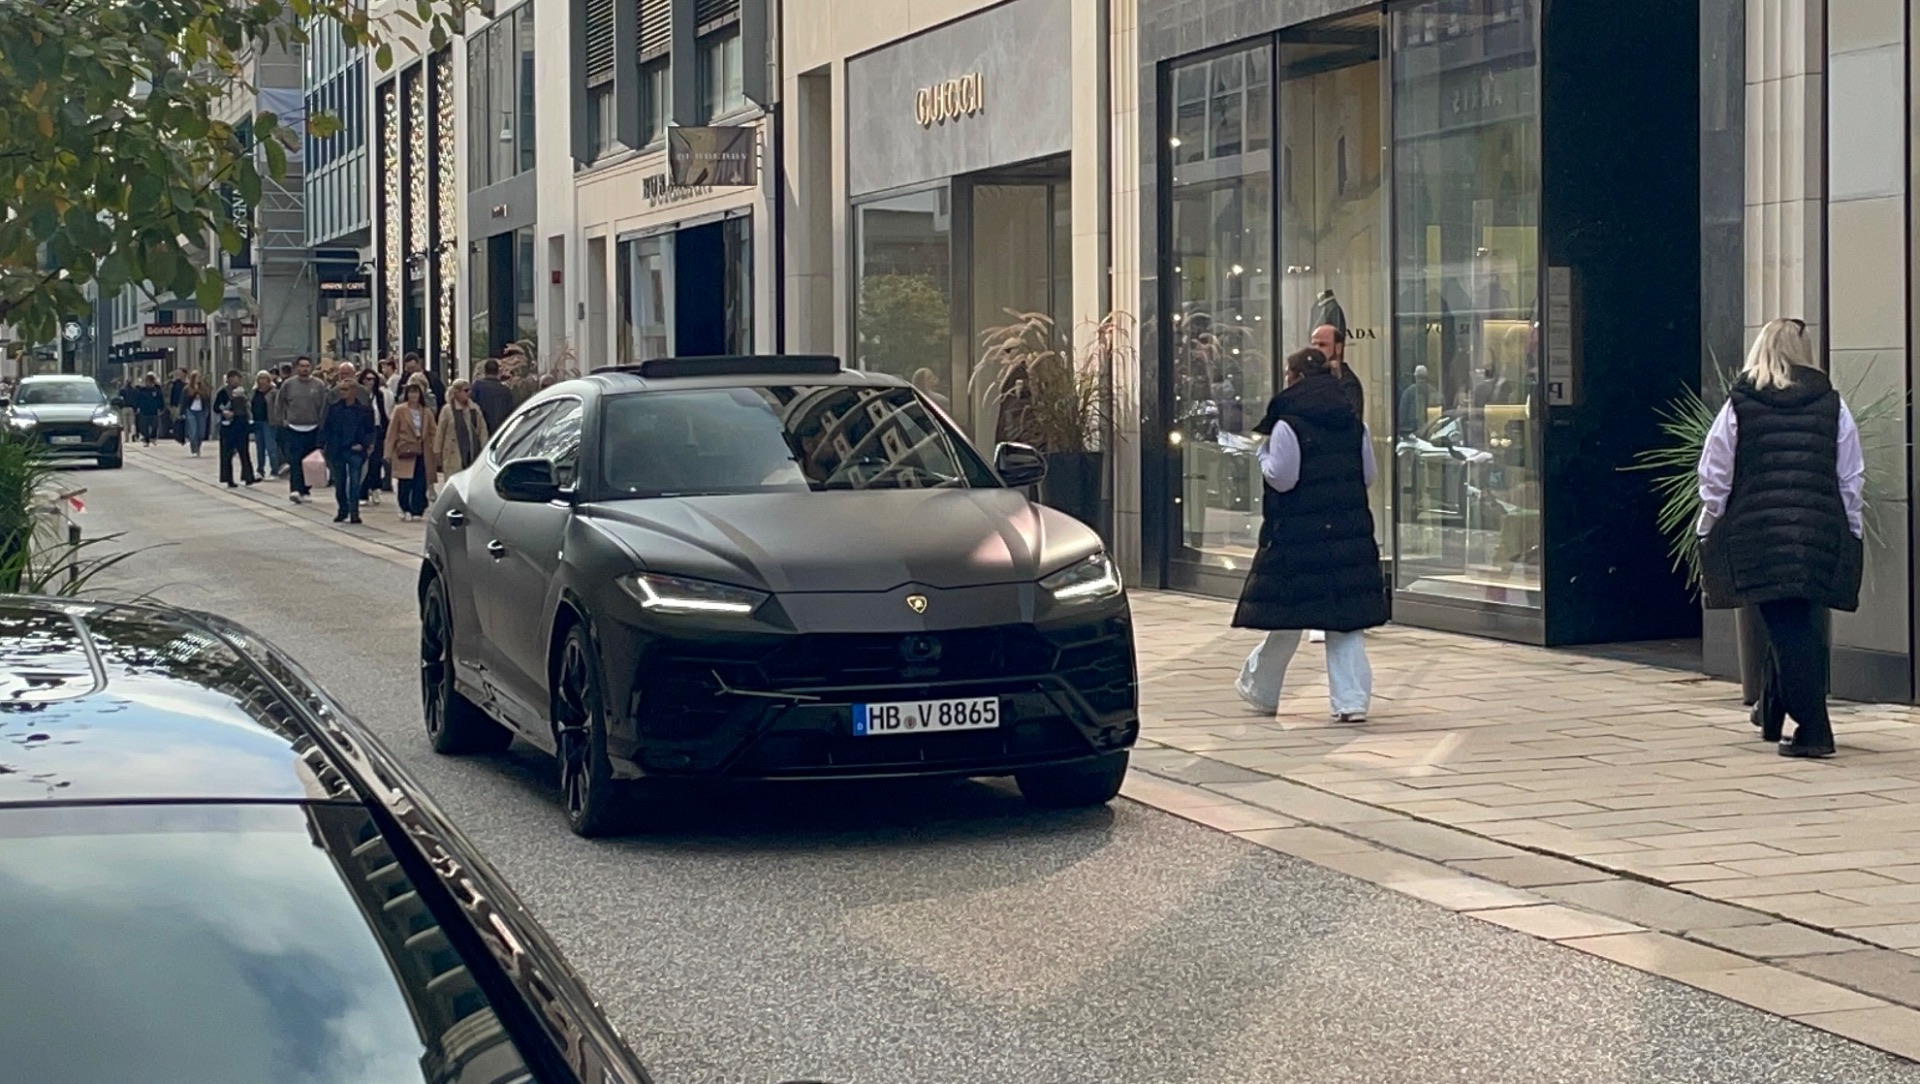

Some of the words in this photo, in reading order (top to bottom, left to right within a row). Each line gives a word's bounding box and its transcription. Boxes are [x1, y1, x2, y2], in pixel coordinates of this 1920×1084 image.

[915, 72, 983, 125] GUCCI
[1346, 328, 1376, 340] ADA
[856, 722, 864, 731] D
[868, 705, 900, 730] HB
[917, 703, 932, 727] V
[938, 700, 997, 726] 8865
